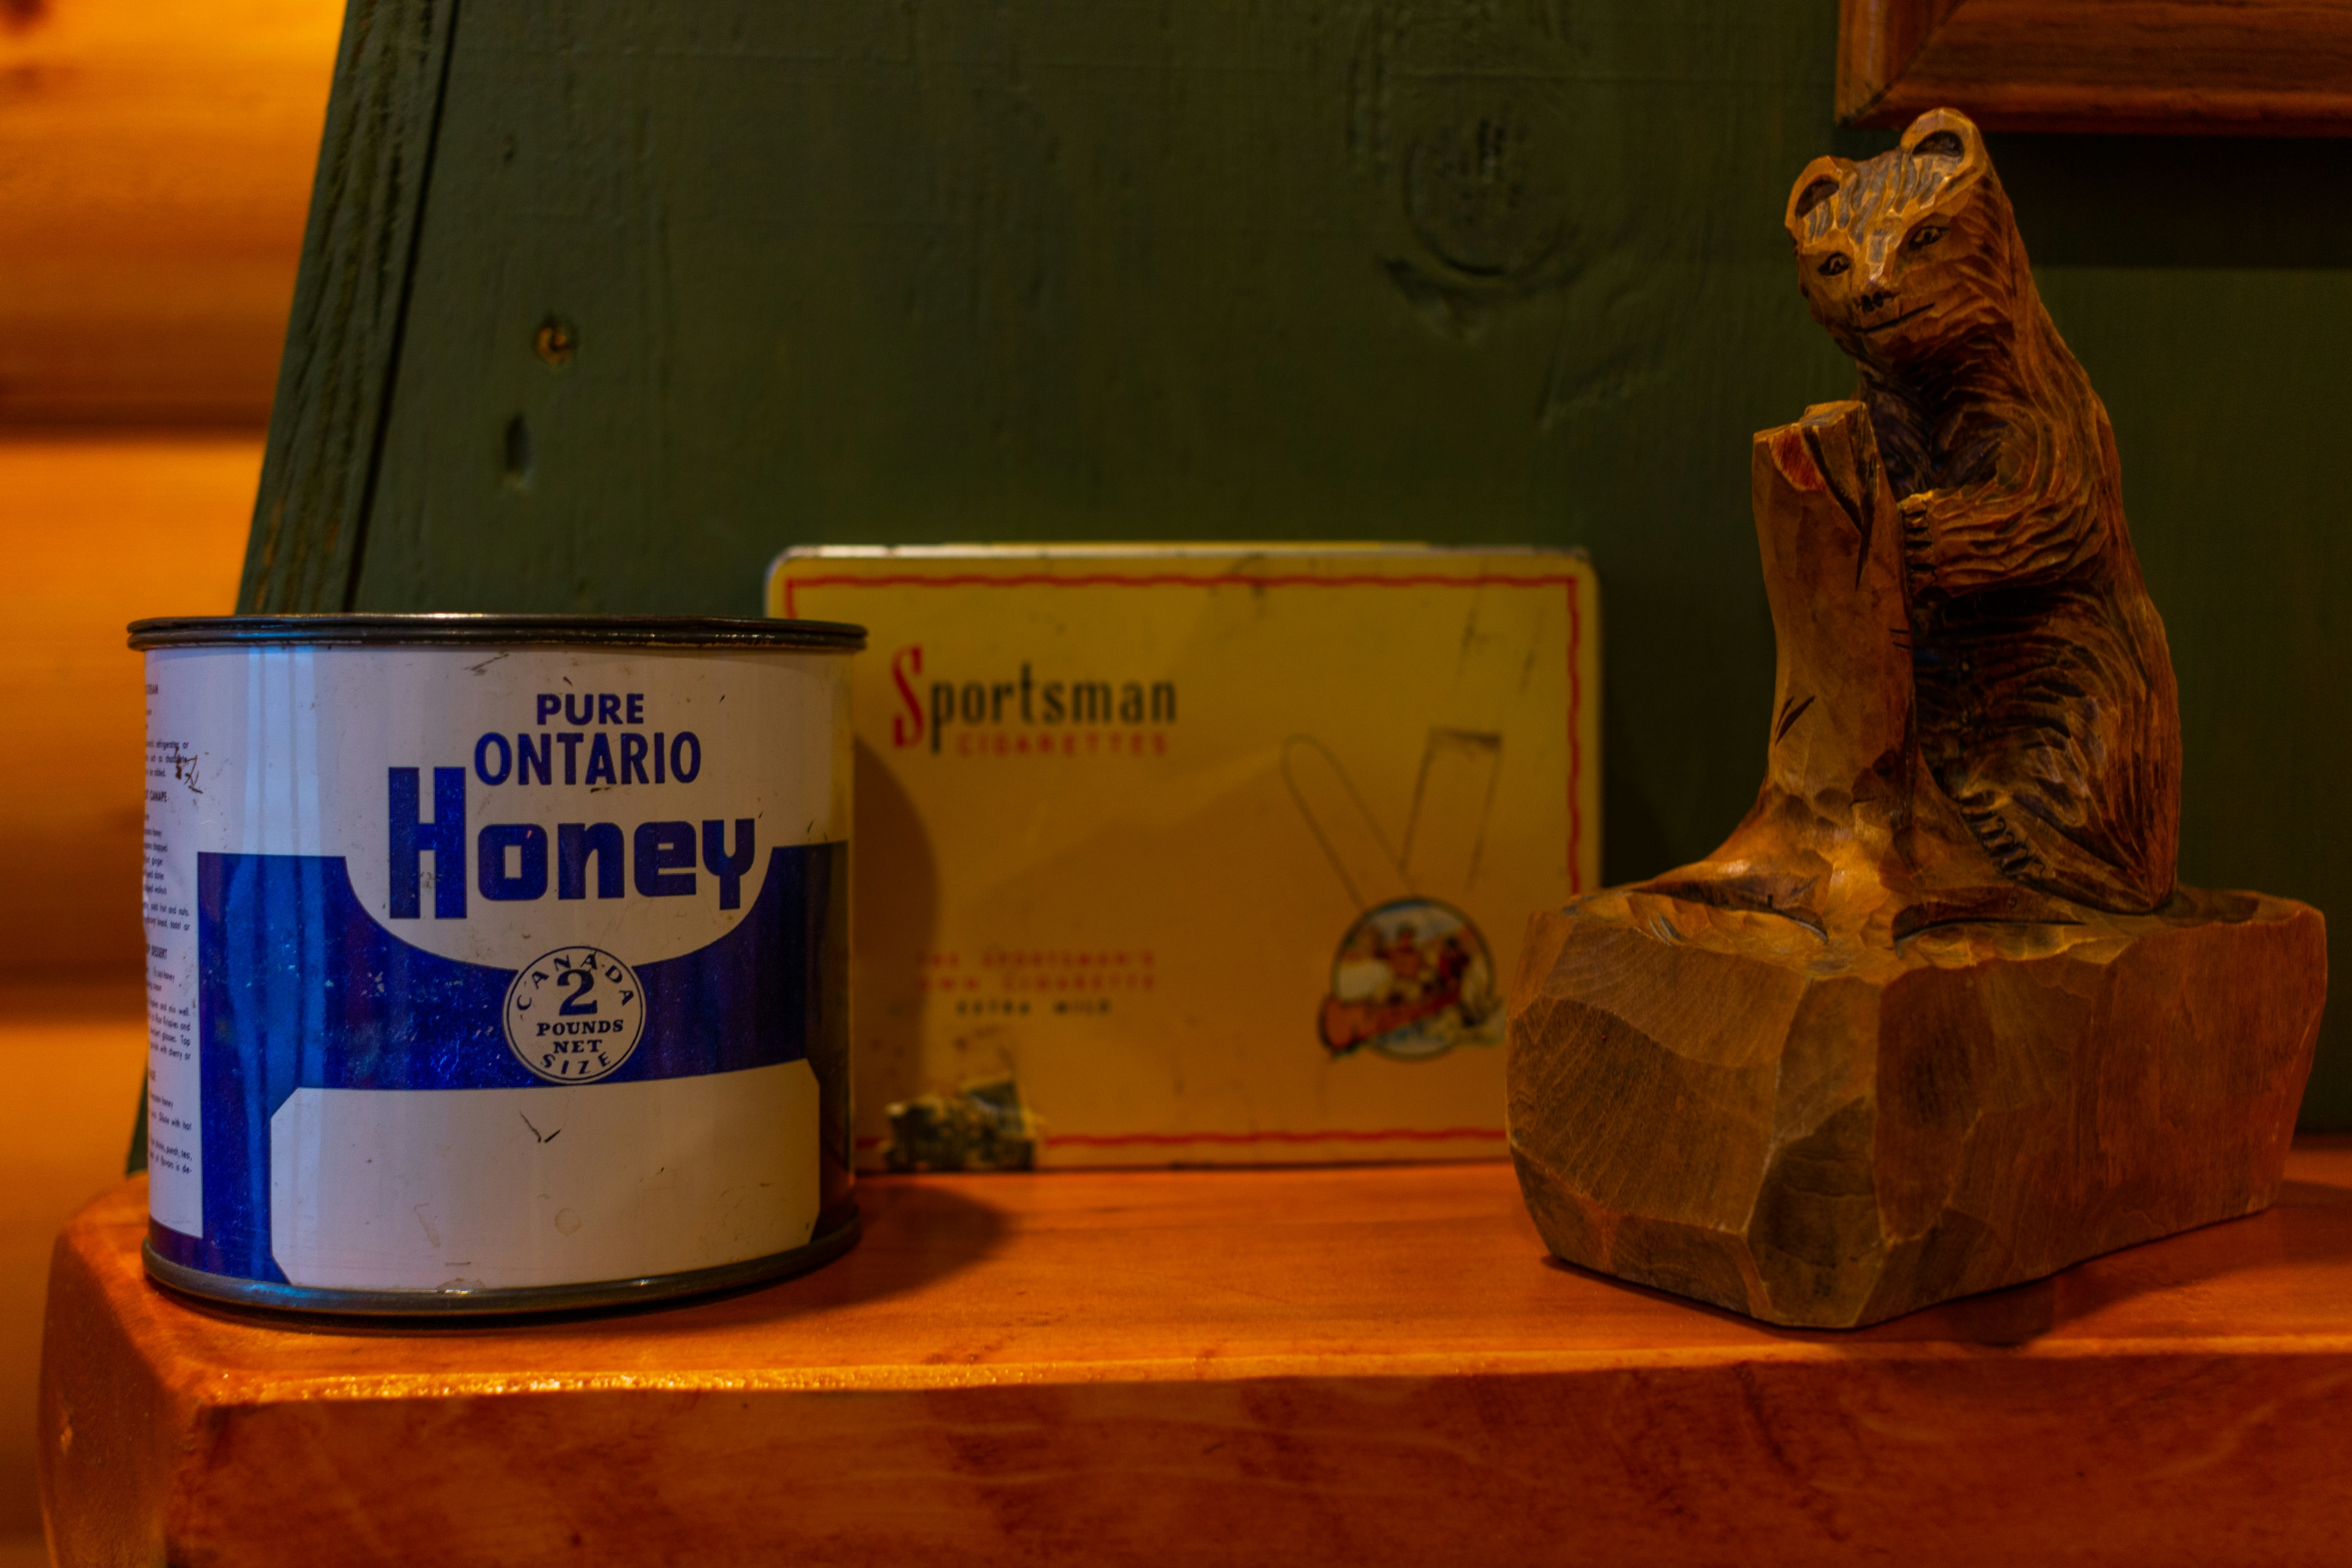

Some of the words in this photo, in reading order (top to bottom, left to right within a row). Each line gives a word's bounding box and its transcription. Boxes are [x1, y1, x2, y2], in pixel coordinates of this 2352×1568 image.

[537, 693, 644, 725] PURE
[891, 643, 1176, 756] Sportsman
[474, 732, 701, 786] ONTARIO
[388, 766, 755, 919] Honey
[517, 953, 635, 1011] CANADA
[557, 969, 598, 1016] 2
[181, 1022, 190, 1031] and
[181, 1034, 190, 1047] Top
[536, 1019, 624, 1036] POUNDS
[553, 1039, 603, 1054] NET
[542, 1051, 611, 1075] SIZE
[183, 1120, 192, 1131] hot
